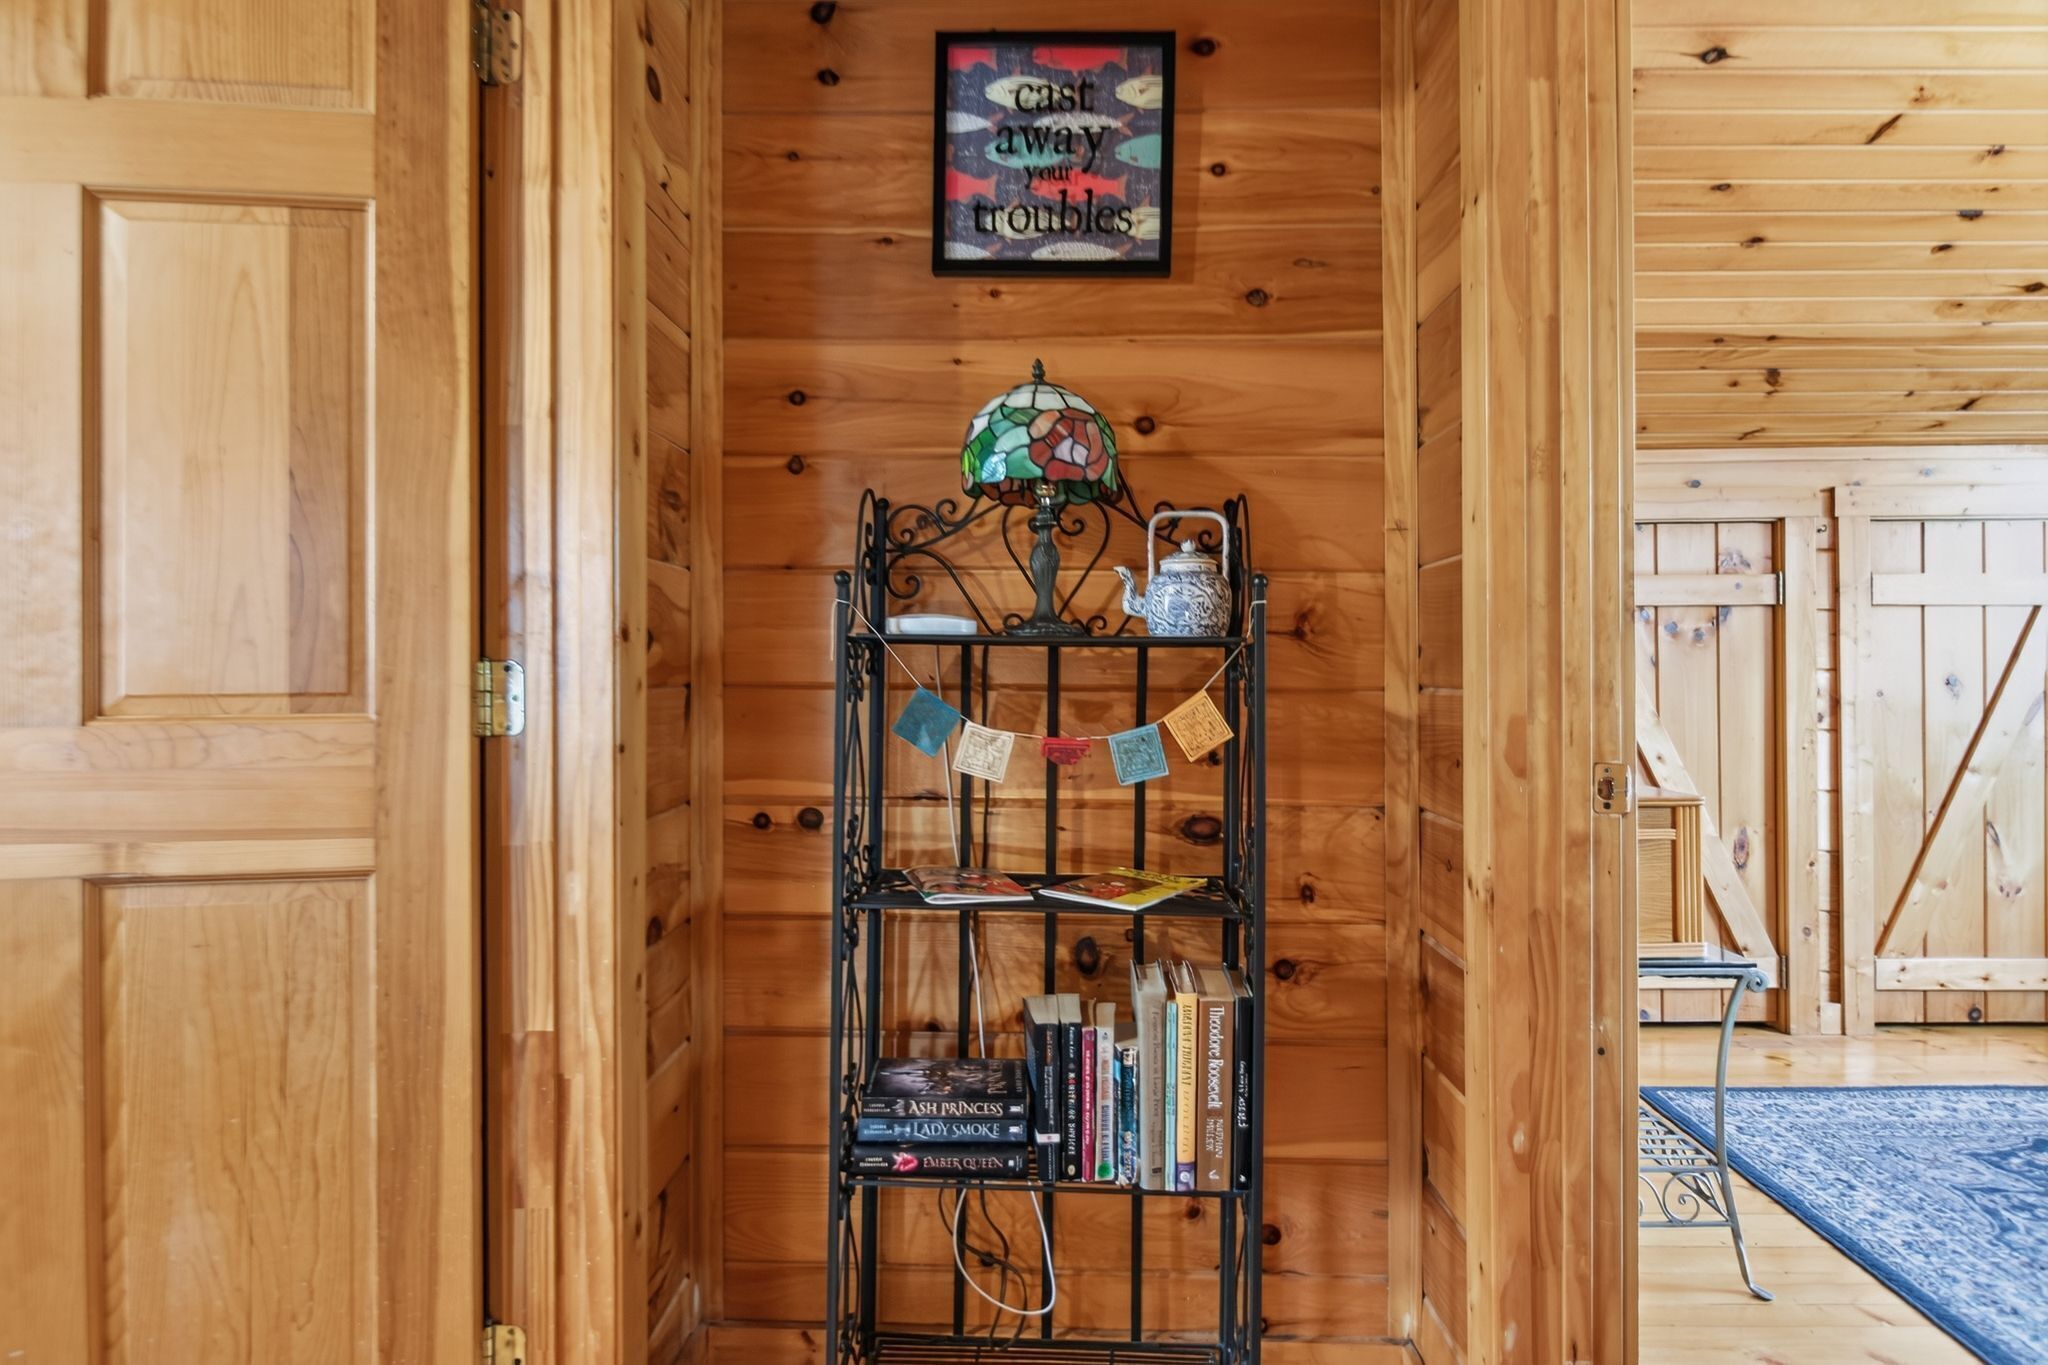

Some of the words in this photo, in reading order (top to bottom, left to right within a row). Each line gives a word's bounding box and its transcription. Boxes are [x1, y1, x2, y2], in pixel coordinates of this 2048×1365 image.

[1014, 77, 1096, 113] cast
[994, 124, 1112, 173] away
[1023, 165, 1073, 190] your
[973, 188, 1132, 234] troubles
[1208, 1006, 1225, 1057] Theodore
[1206, 1059, 1224, 1110] Roosevelt
[908, 1100, 938, 1116] ASH
[941, 1101, 1004, 1116] PRINCESS
[913, 1121, 950, 1139] LADY
[951, 1122, 1000, 1139] SMOKE
[923, 1156, 962, 1170] EMBER
[962, 1156, 1004, 1170] QUEEN
